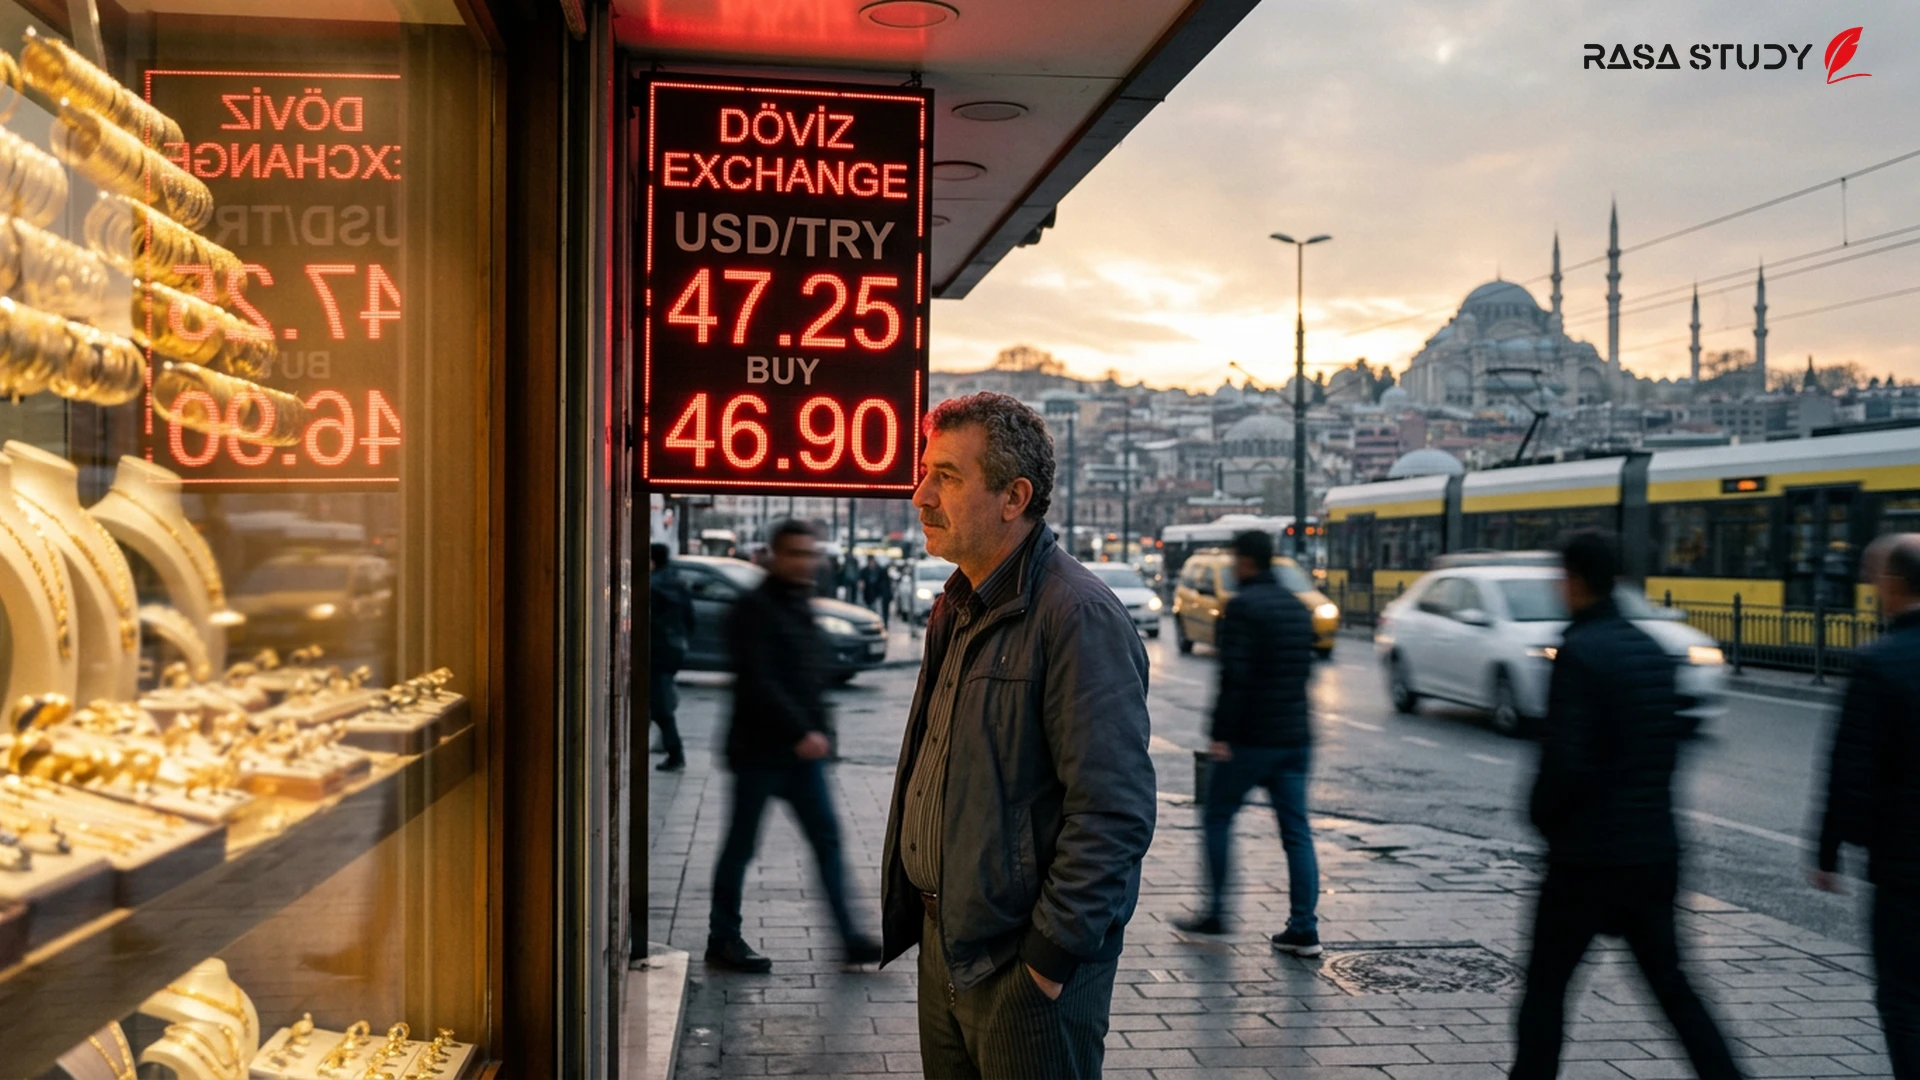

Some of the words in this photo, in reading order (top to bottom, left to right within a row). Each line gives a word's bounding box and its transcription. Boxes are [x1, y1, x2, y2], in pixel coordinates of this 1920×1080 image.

[720, 103, 854, 150] DÖVİZ
[663, 151, 908, 199] EXCHANGE
[674, 211, 896, 260] USD/TRY
[668, 268, 901, 350] 47.25
[746, 356, 820, 386] BUY
[665, 393, 898, 472] 46.90
